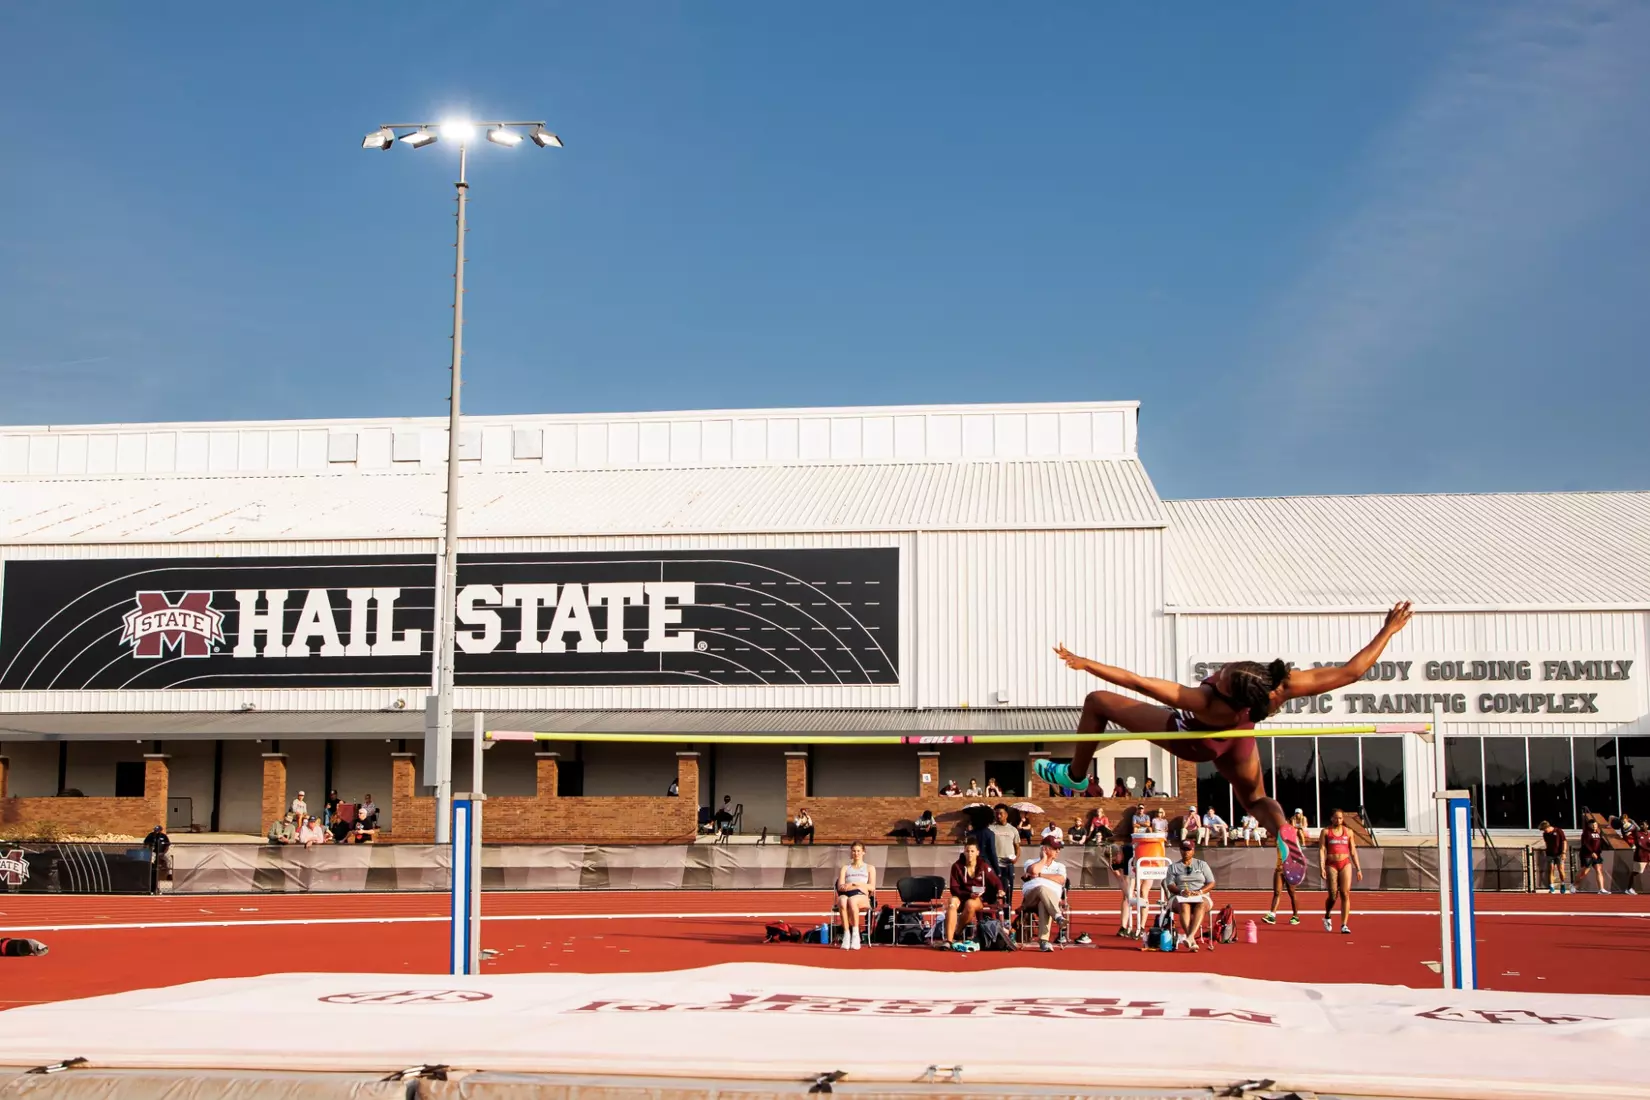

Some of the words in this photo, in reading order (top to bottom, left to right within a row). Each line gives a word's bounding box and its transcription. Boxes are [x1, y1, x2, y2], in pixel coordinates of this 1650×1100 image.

[141, 612, 205, 632] STATE
[233, 588, 421, 658] HAIL
[456, 582, 696, 654] STATE
[1425, 660, 1532, 681] GOLDING
[1543, 660, 1634, 681] FAMILY
[1344, 693, 1467, 714] TRAINING
[1478, 693, 1599, 714] COMPLEX
[919, 735, 954, 744] GILL
[0, 860, 20, 871] ATE
